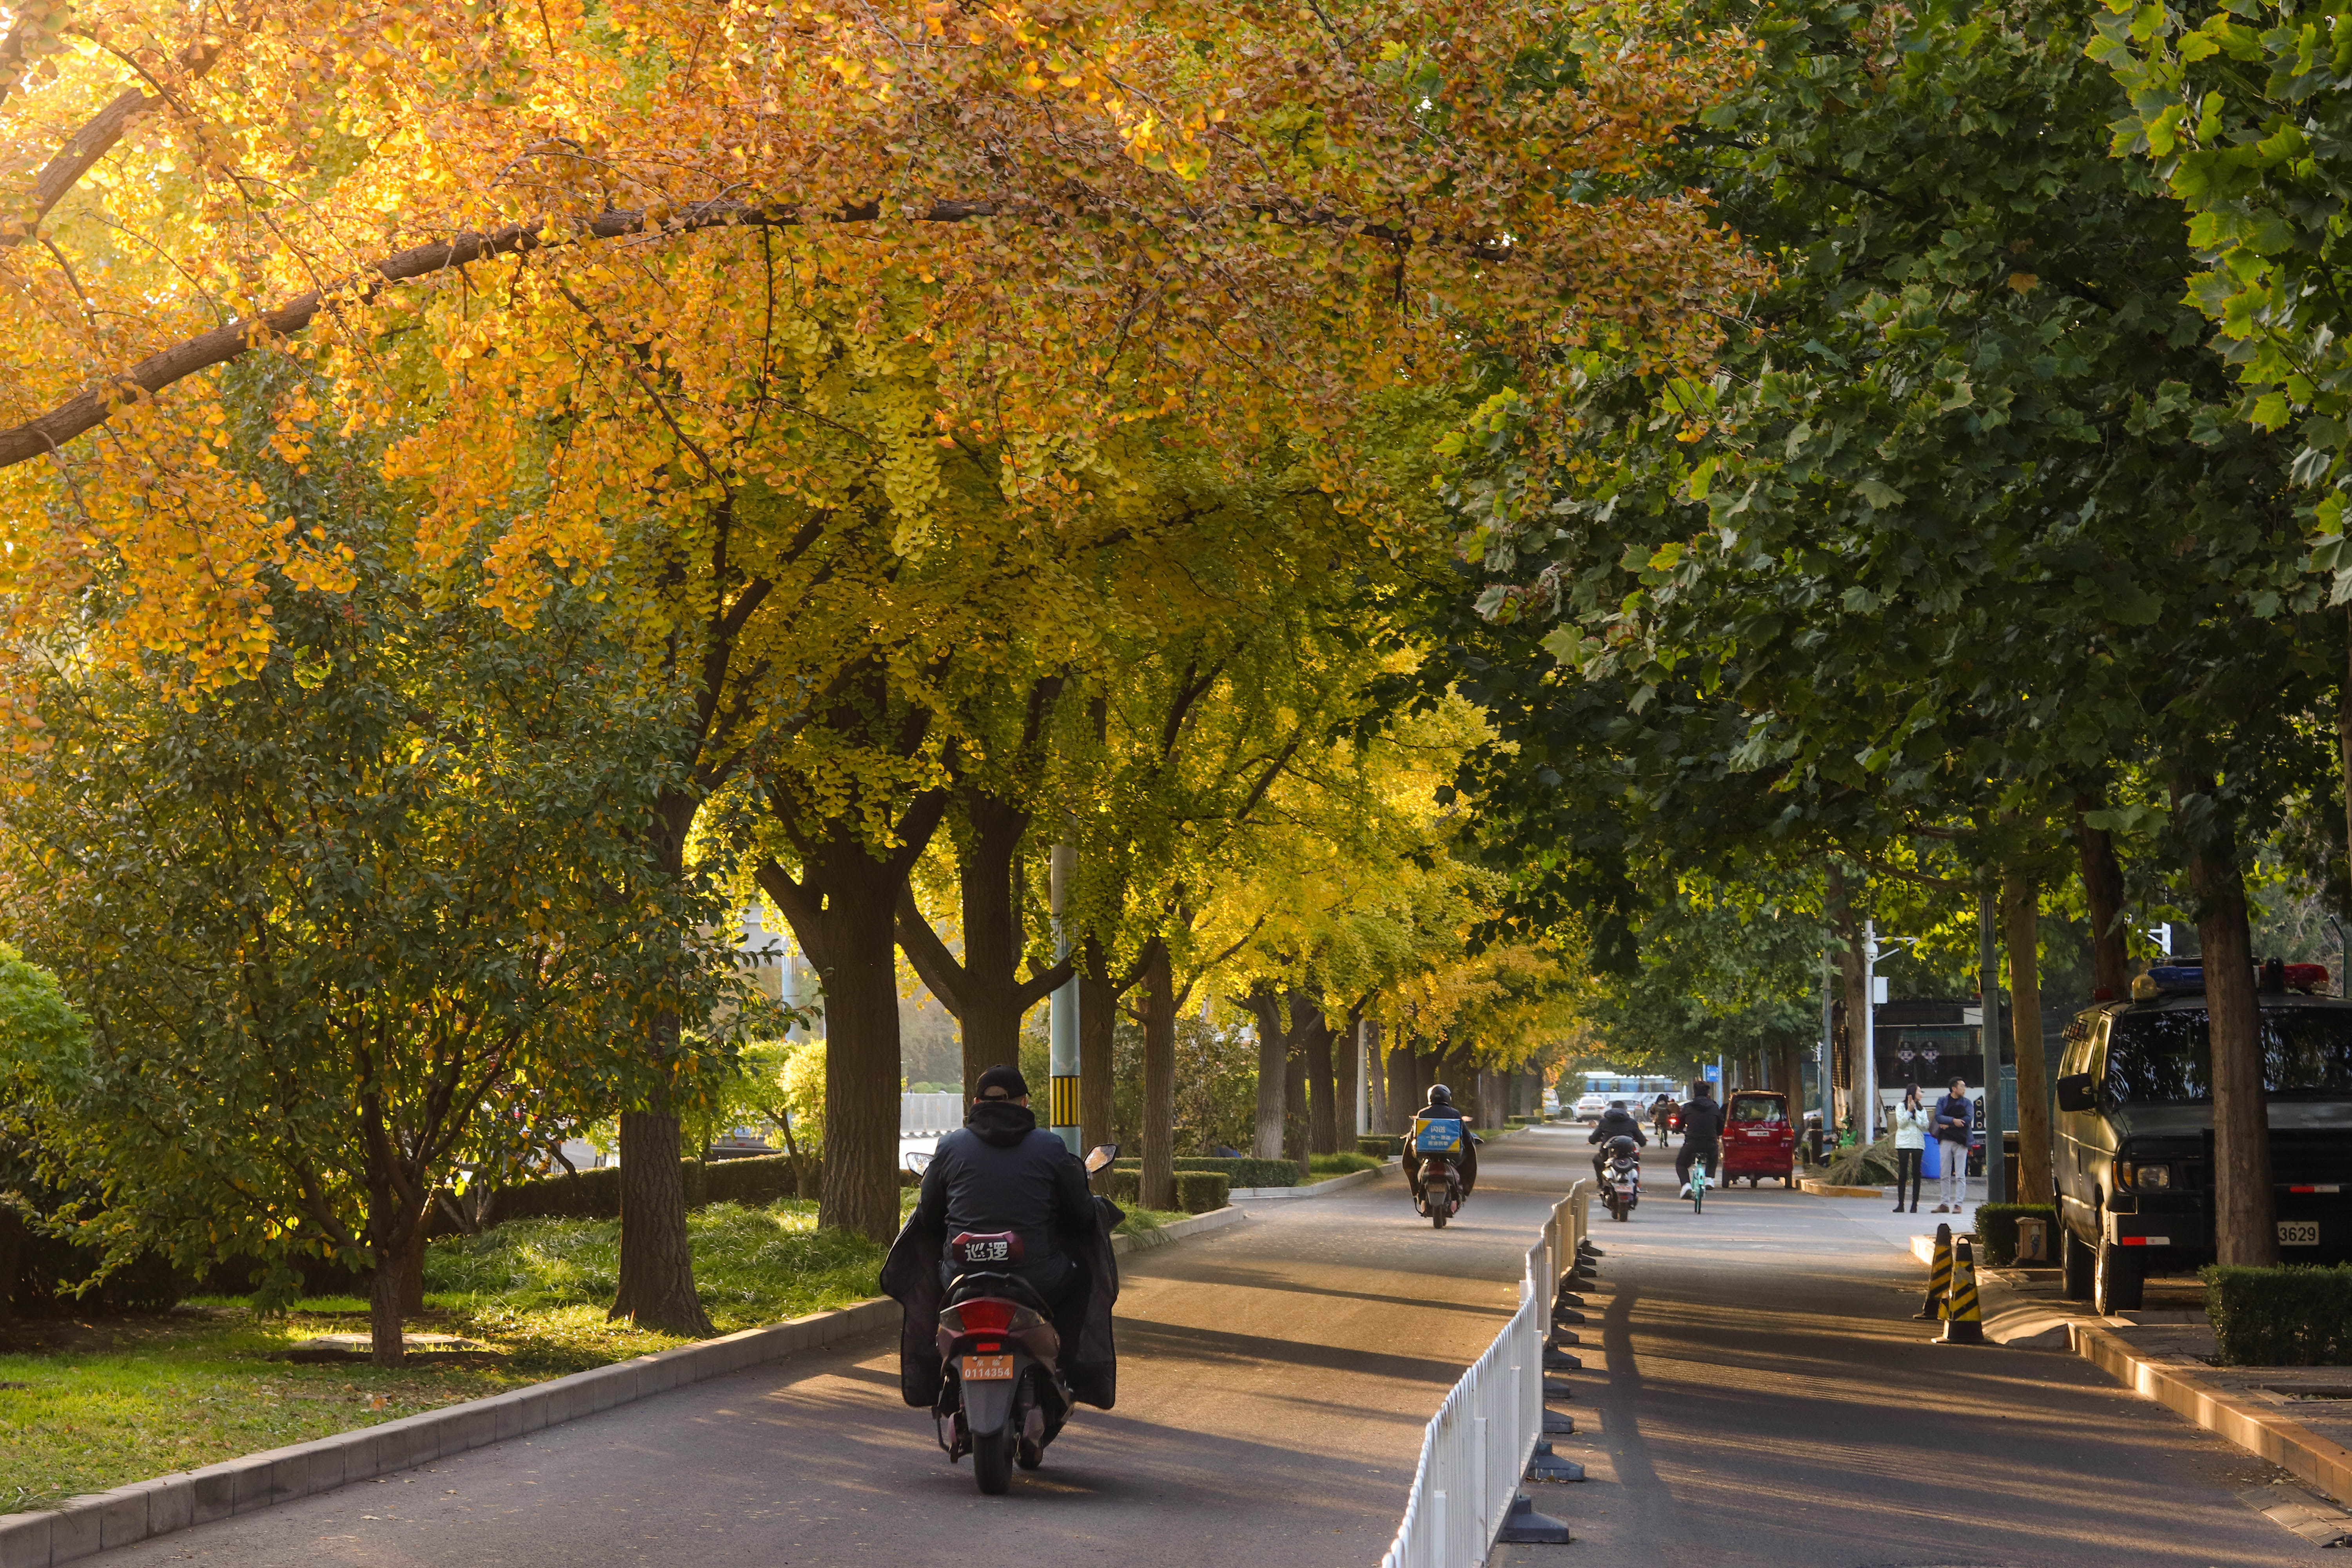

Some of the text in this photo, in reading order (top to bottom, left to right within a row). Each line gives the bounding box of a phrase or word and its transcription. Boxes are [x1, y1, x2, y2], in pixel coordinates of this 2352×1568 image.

[2279, 1227, 2316, 1242] 3629
[965, 1241, 1009, 1262] 巡逻
[965, 1367, 1011, 1378] 0114354
